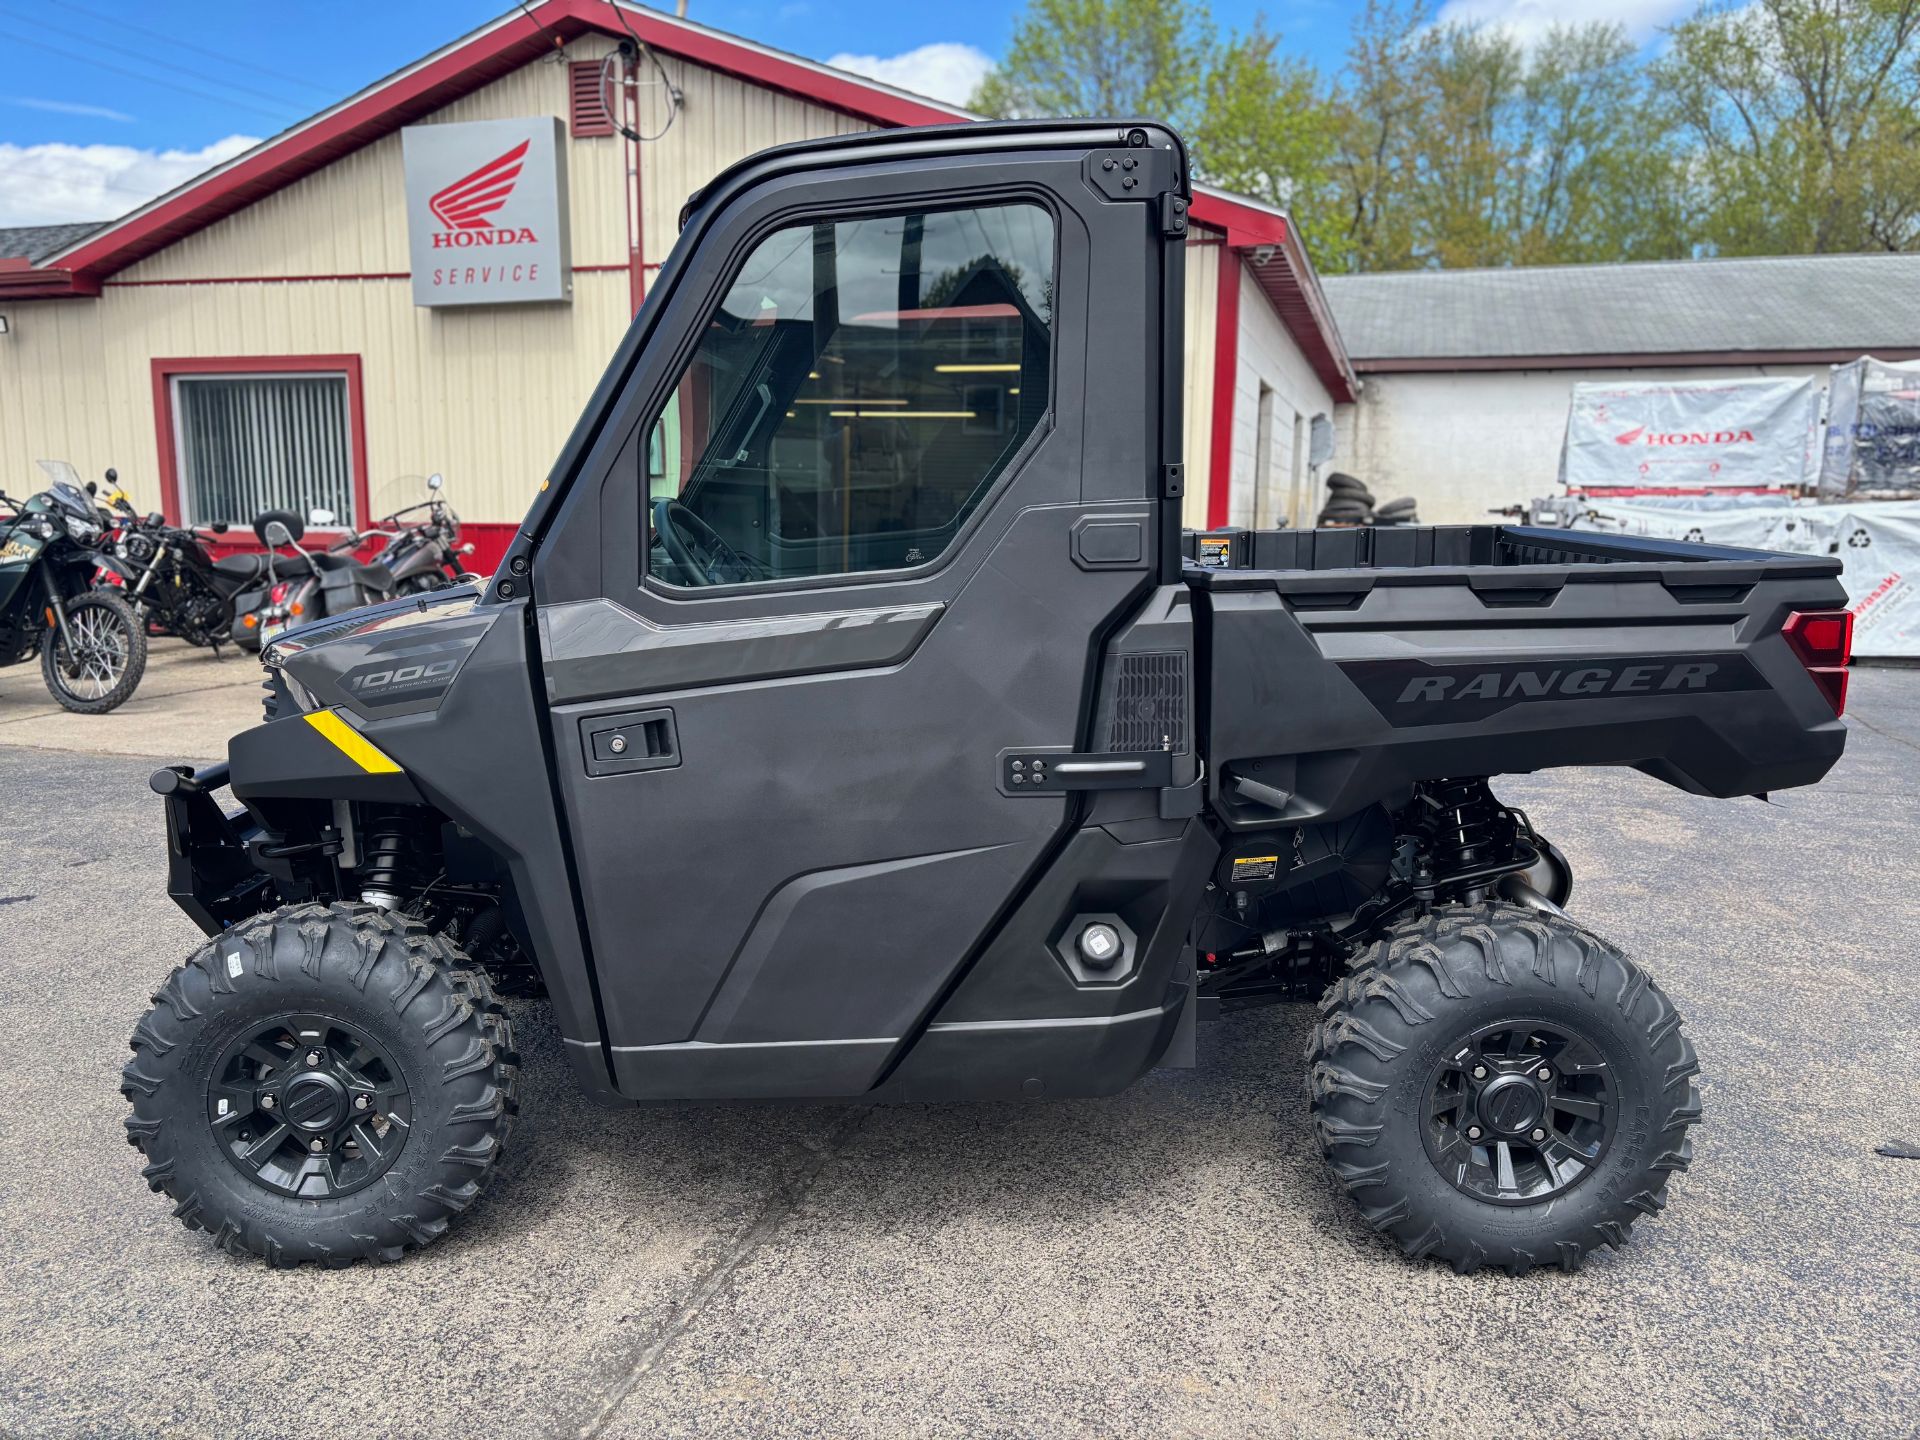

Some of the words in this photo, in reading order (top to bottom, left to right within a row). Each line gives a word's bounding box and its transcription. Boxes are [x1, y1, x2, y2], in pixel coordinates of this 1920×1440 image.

[432, 228, 538, 248] HONDA
[433, 264, 538, 286] SERVICE
[1647, 429, 1755, 446] HONDA
[1851, 570, 1902, 620] wasaki
[351, 659, 458, 691] 1000
[1397, 663, 1718, 702] RANGER
